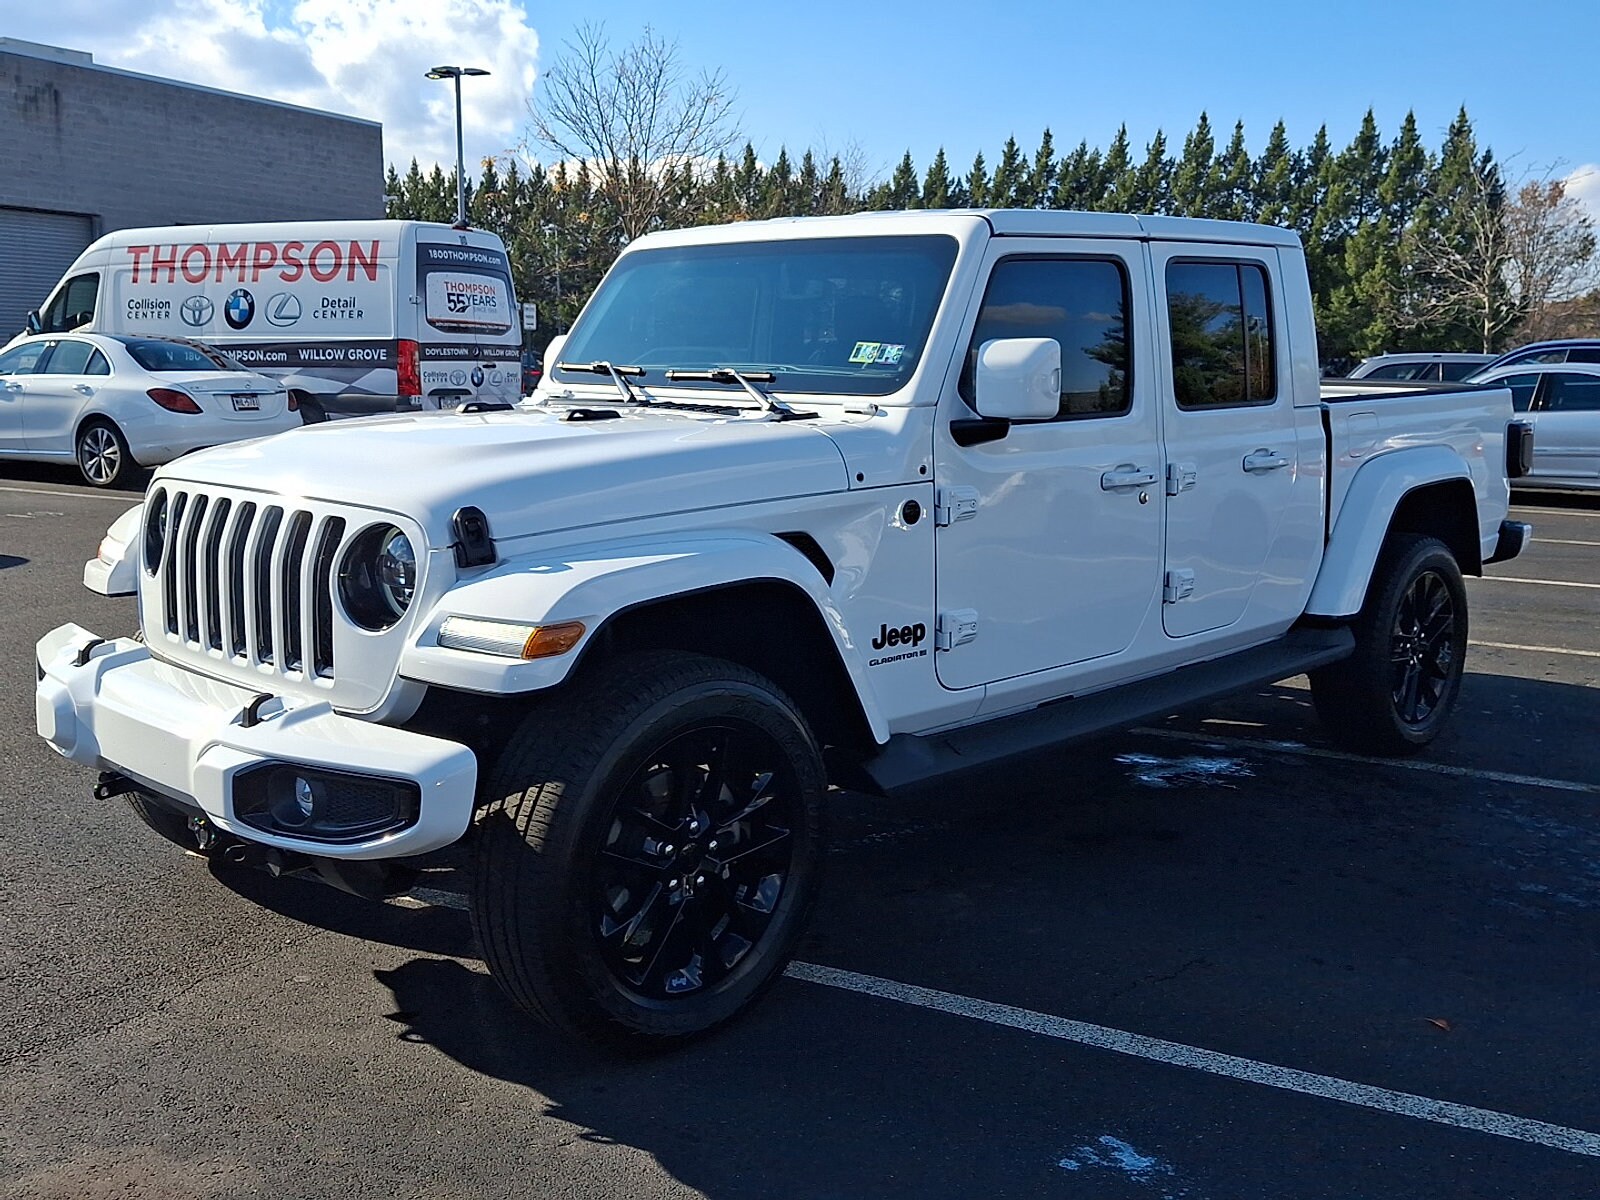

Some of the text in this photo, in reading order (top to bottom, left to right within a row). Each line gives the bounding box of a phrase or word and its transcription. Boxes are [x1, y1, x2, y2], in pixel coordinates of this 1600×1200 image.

[127, 239, 380, 284] THOMPSON
[428, 250, 501, 265] 1800THOMPSON.com
[445, 281, 496, 296] THOMPSON
[127, 299, 171, 310] Collision
[321, 297, 356, 309] Detail
[466, 294, 497, 308] YEARS
[127, 310, 171, 319] CENTER
[312, 310, 364, 319] CENTER
[298, 348, 387, 361] WILLOW GROVE
[425, 348, 469, 356] DOYLESTOWN
[872, 623, 925, 650] Jeep
[869, 651, 918, 666] GLADIATOR
